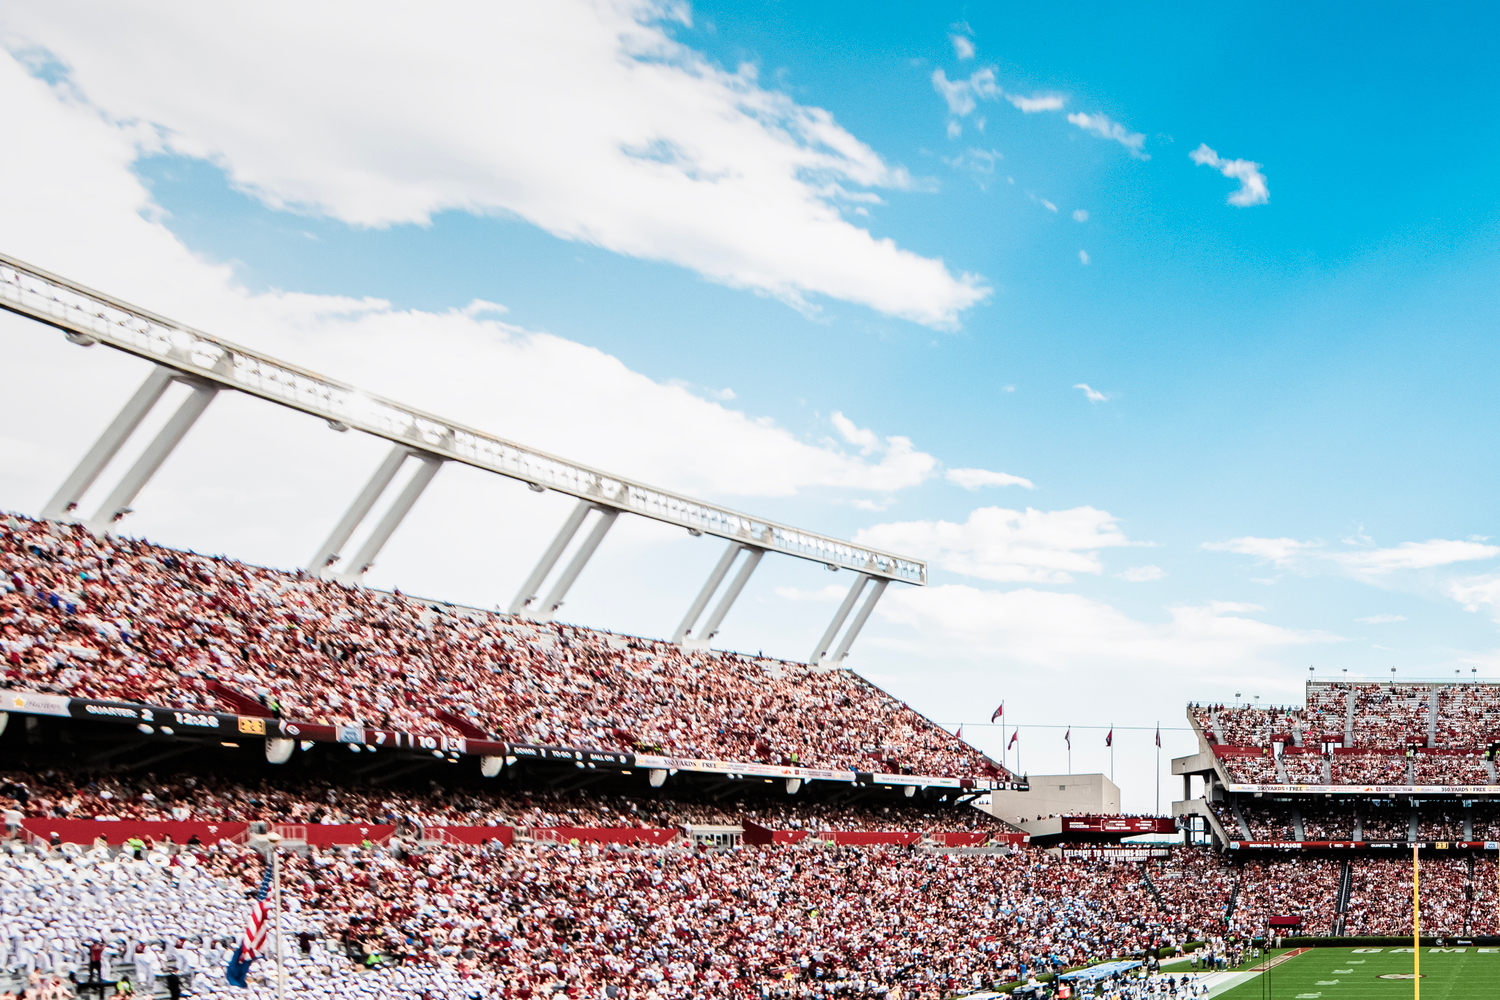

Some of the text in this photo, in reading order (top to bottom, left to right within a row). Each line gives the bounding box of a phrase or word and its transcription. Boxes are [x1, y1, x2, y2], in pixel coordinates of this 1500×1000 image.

[85, 704, 138, 719] QUARTER:
[140, 708, 154, 721] 2
[174, 711, 219, 728] 12:28
[374, 731, 437, 749] 7 10
[540, 748, 546, 758] 1
[589, 753, 605, 761] BALL
[674, 759, 697, 768] YARDS
[701, 761, 717, 769] FREE
[1064, 849, 1092, 857] WELCOME
[1093, 849, 1101, 857] TO
[1103, 849, 1151, 857] WILLIAMS-BRICE
